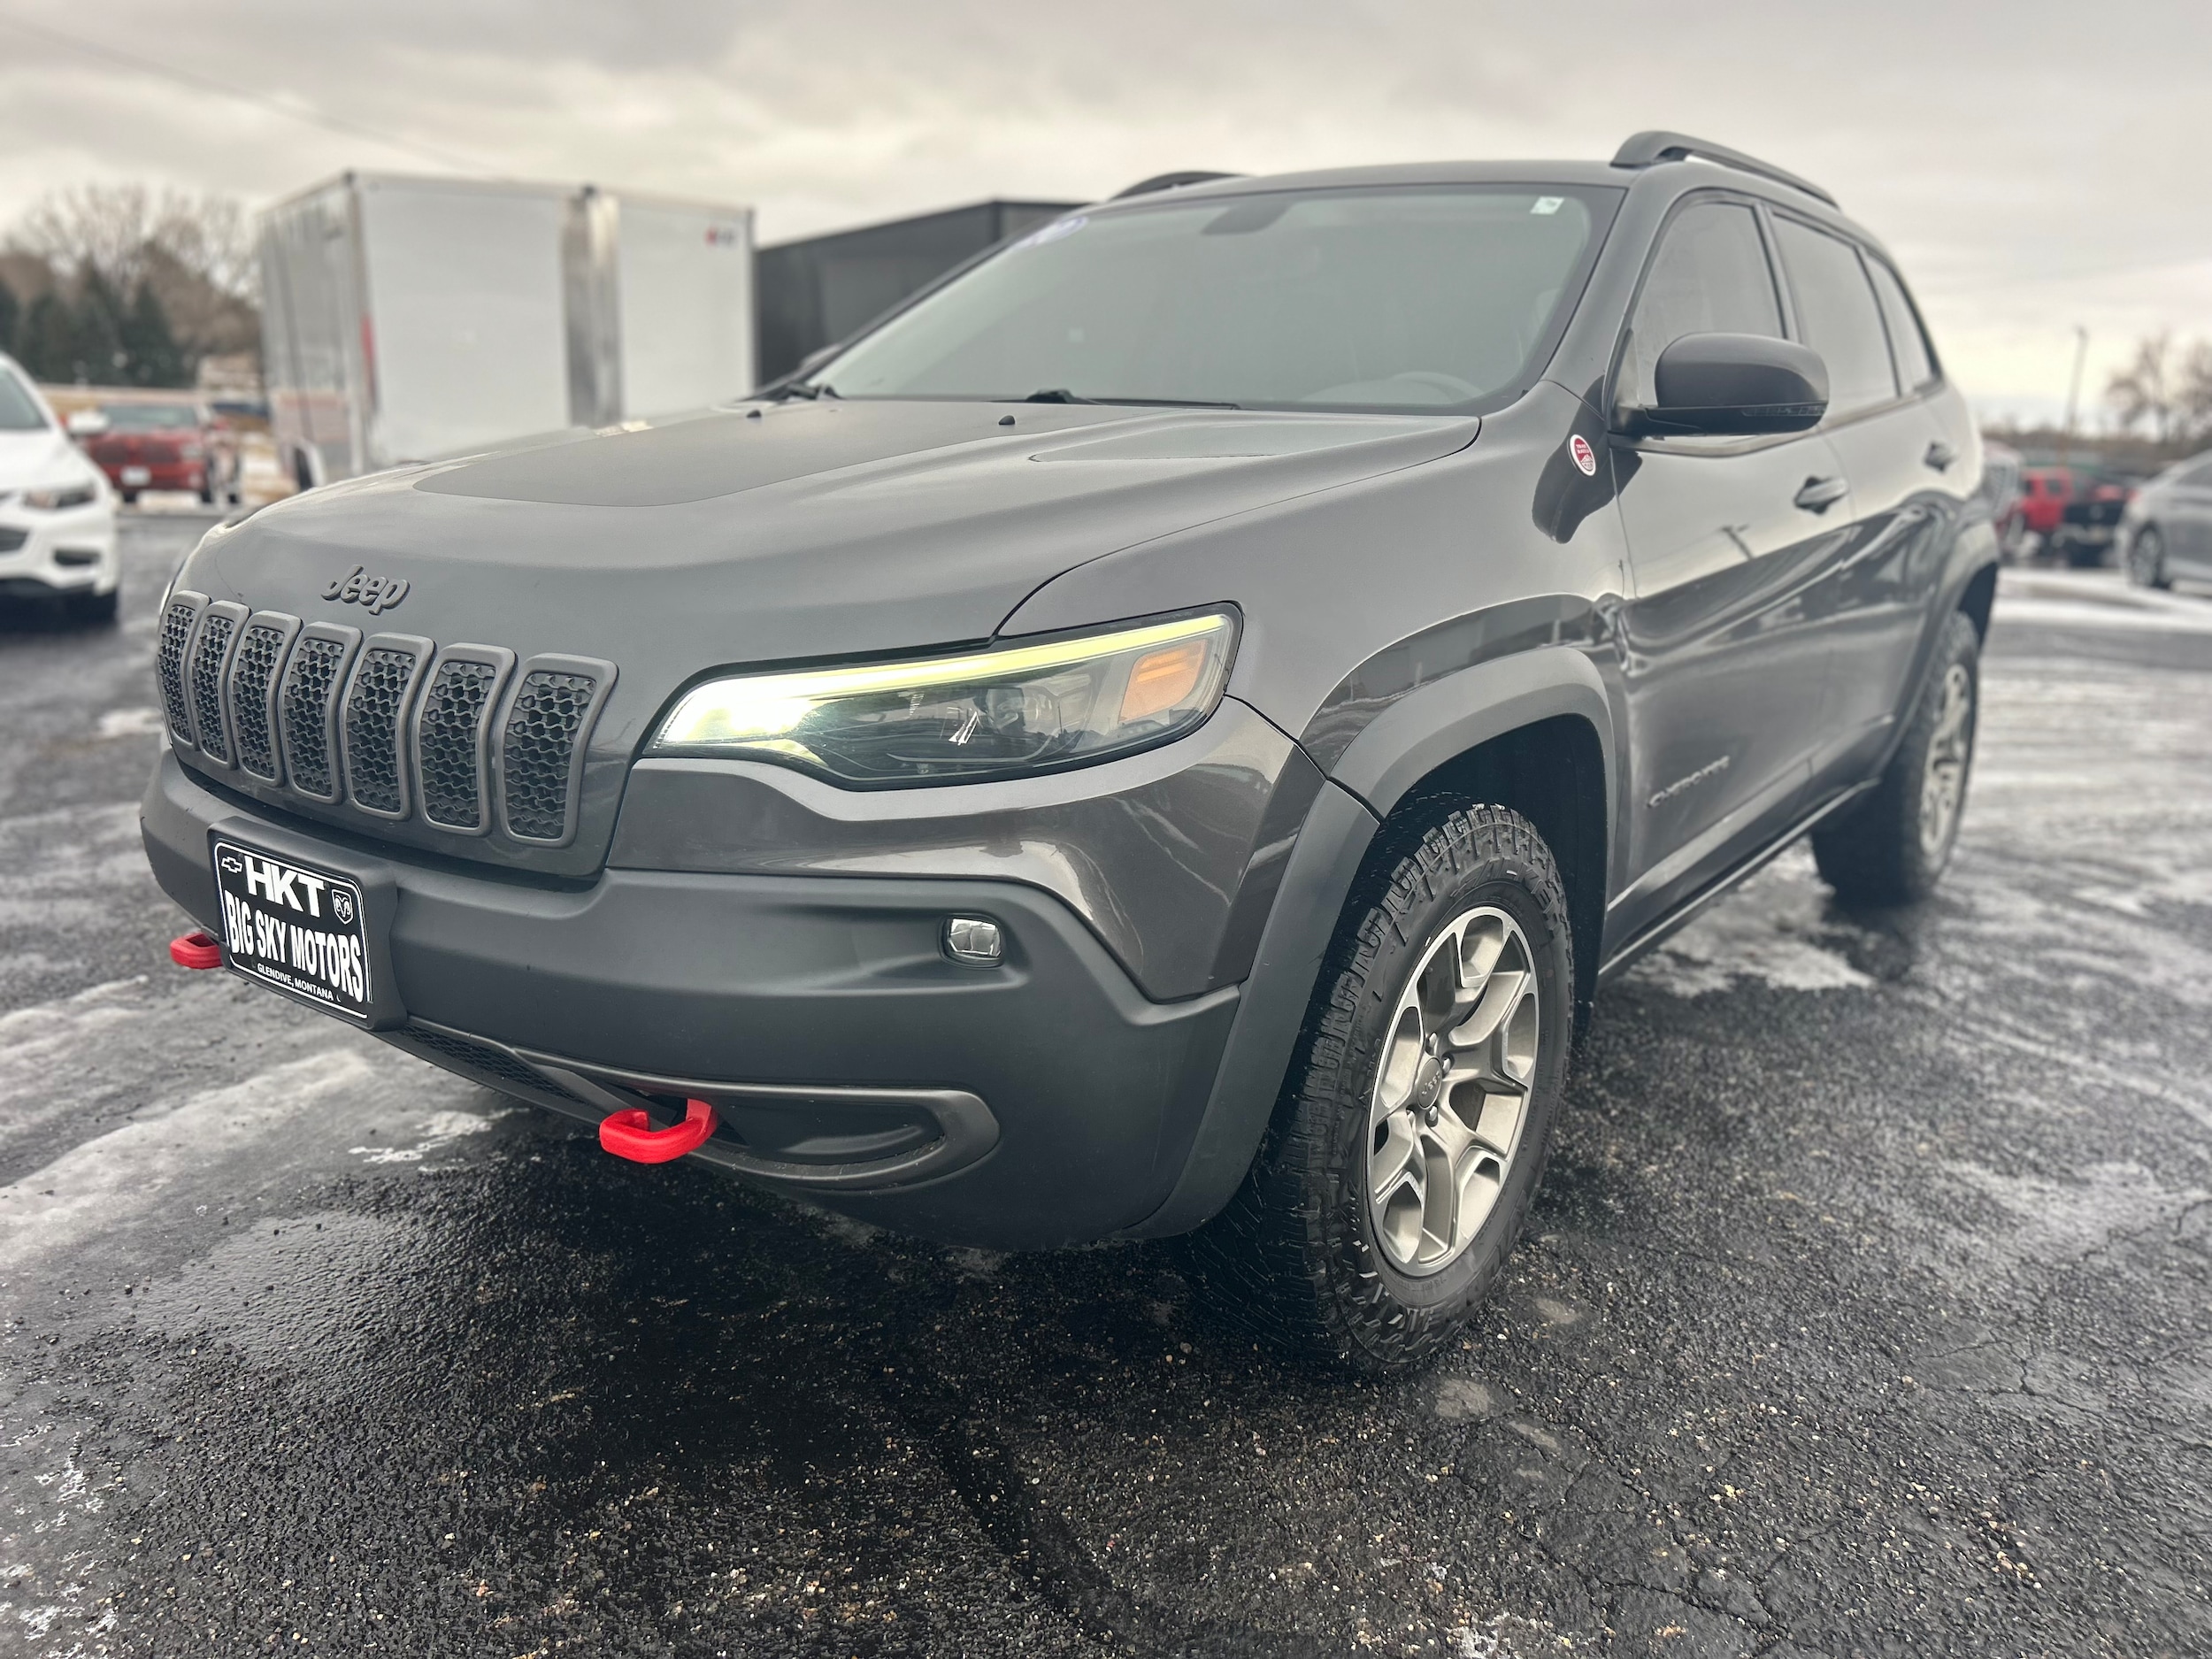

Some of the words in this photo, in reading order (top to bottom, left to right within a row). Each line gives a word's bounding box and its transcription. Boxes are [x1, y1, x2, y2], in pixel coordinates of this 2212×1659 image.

[320, 564, 411, 616] Jeep
[244, 856, 325, 918] HKT
[225, 890, 254, 956] BIG
[256, 910, 287, 964] SKY
[290, 924, 364, 1002] MOTORS
[257, 963, 294, 987] GLENDIVE,
[295, 977, 334, 1001] MONTANA
